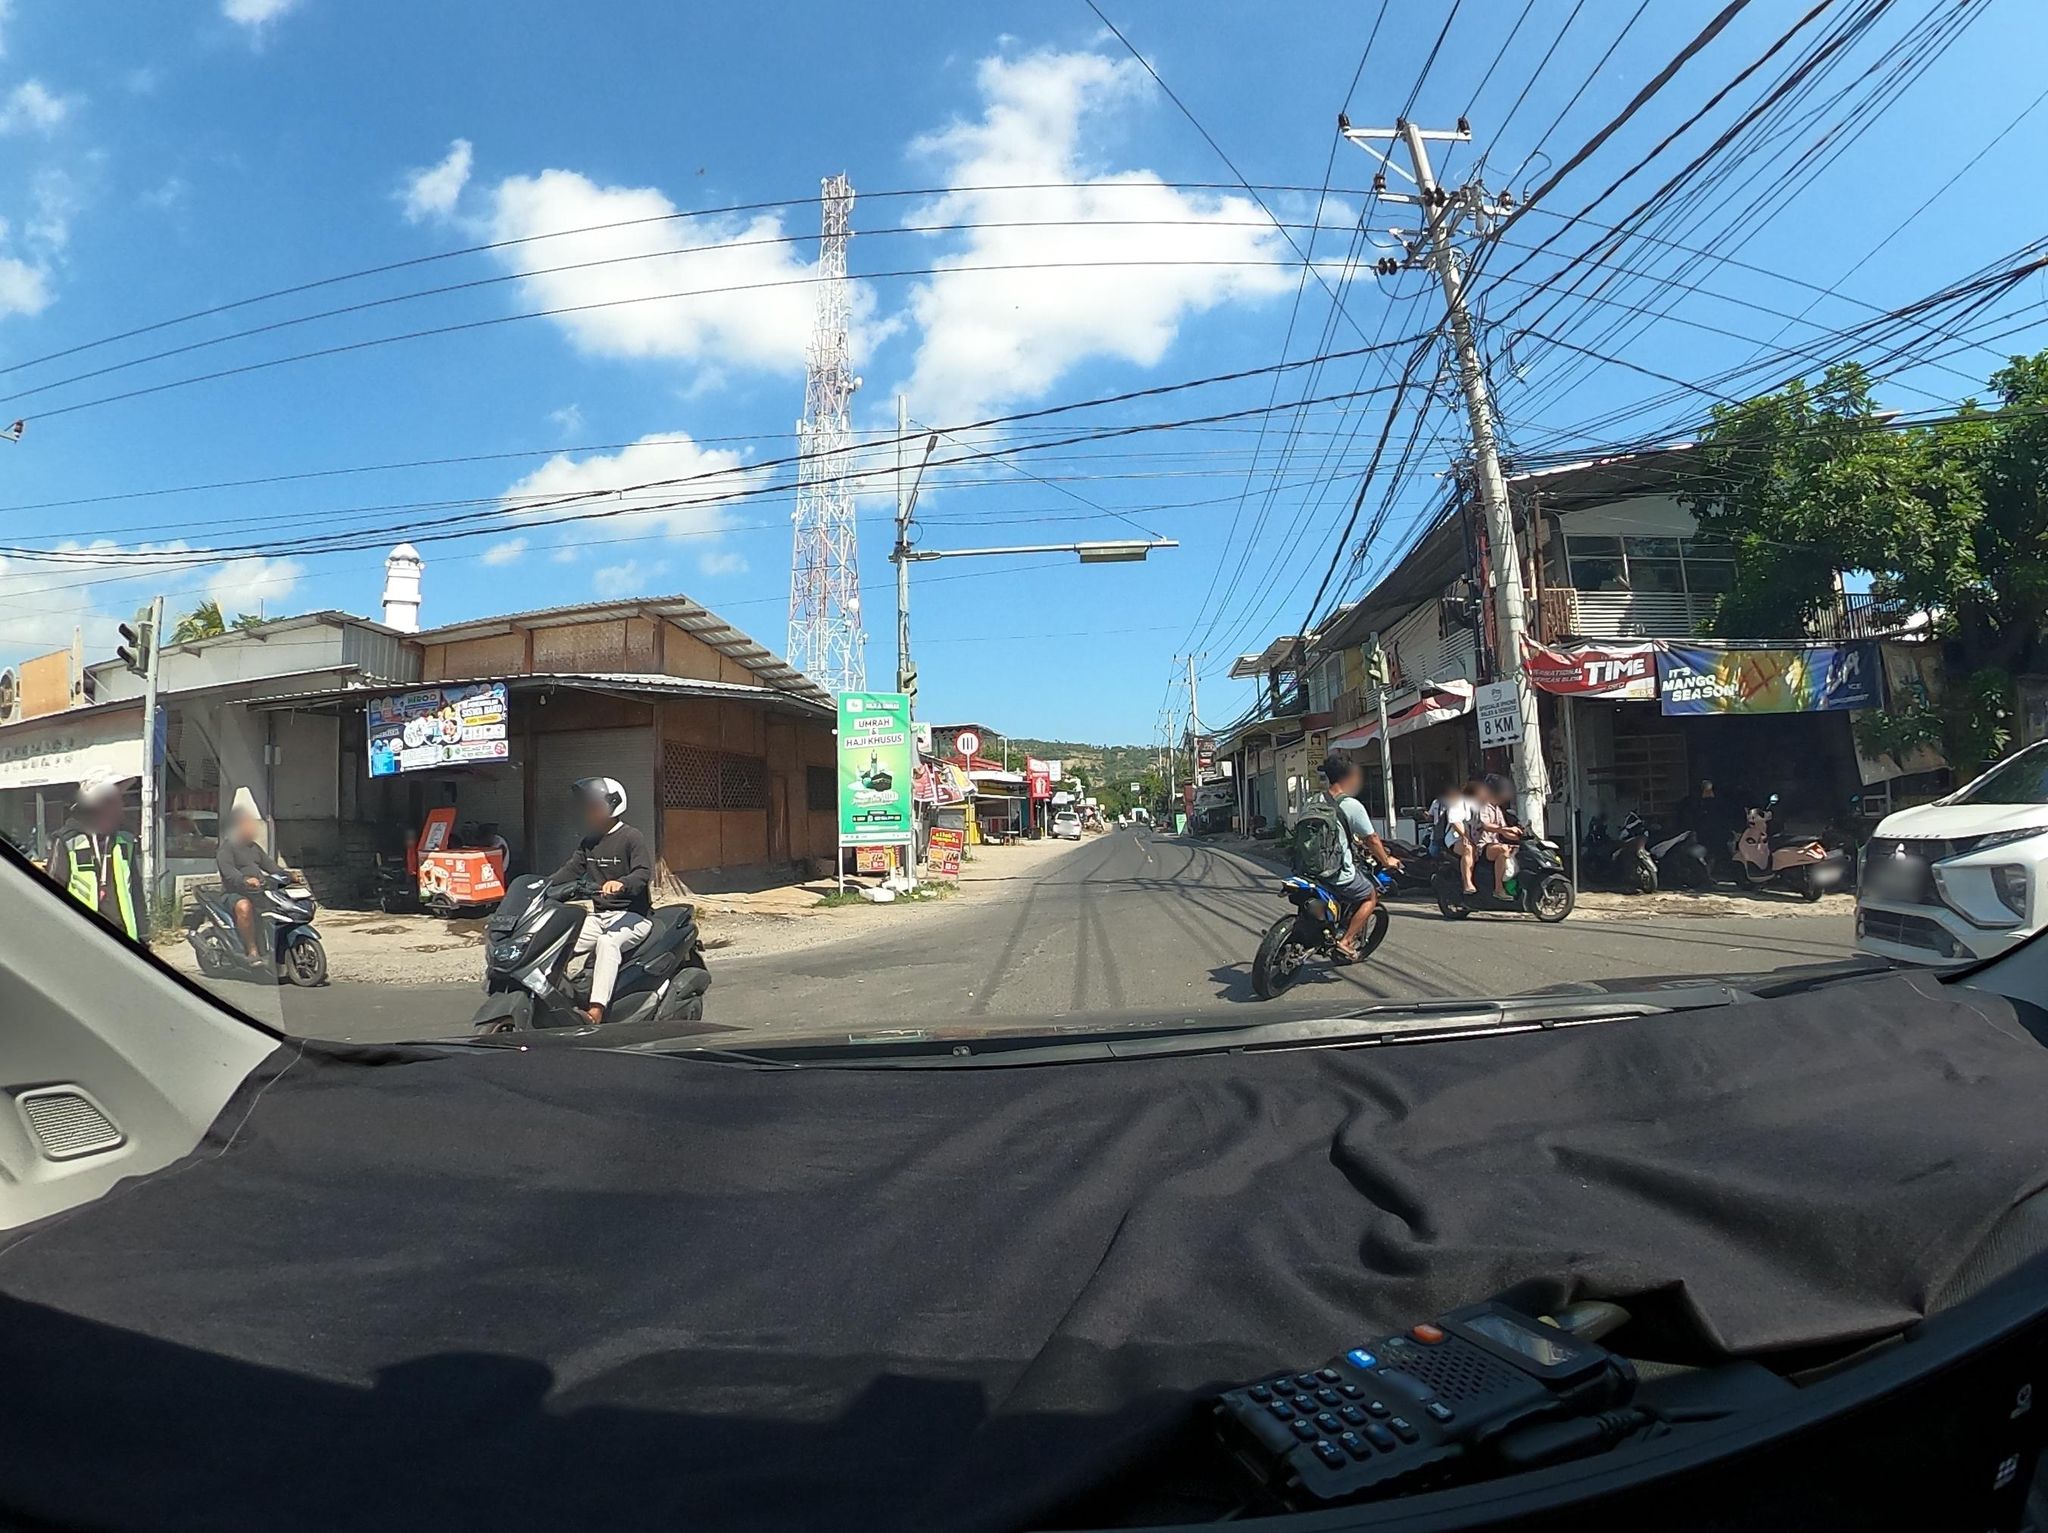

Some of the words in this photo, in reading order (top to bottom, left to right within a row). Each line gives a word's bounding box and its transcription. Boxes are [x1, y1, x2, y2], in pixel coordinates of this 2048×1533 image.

[1583, 658, 1646, 687] TIME
[1662, 674, 1716, 692] MANGO
[858, 718, 890, 728] UMRAH
[1484, 720, 1491, 735] 8
[1494, 715, 1514, 735] KM
[871, 727, 877, 736] &
[846, 737, 867, 747] HAJI
[867, 734, 902, 745] KHUSUS
